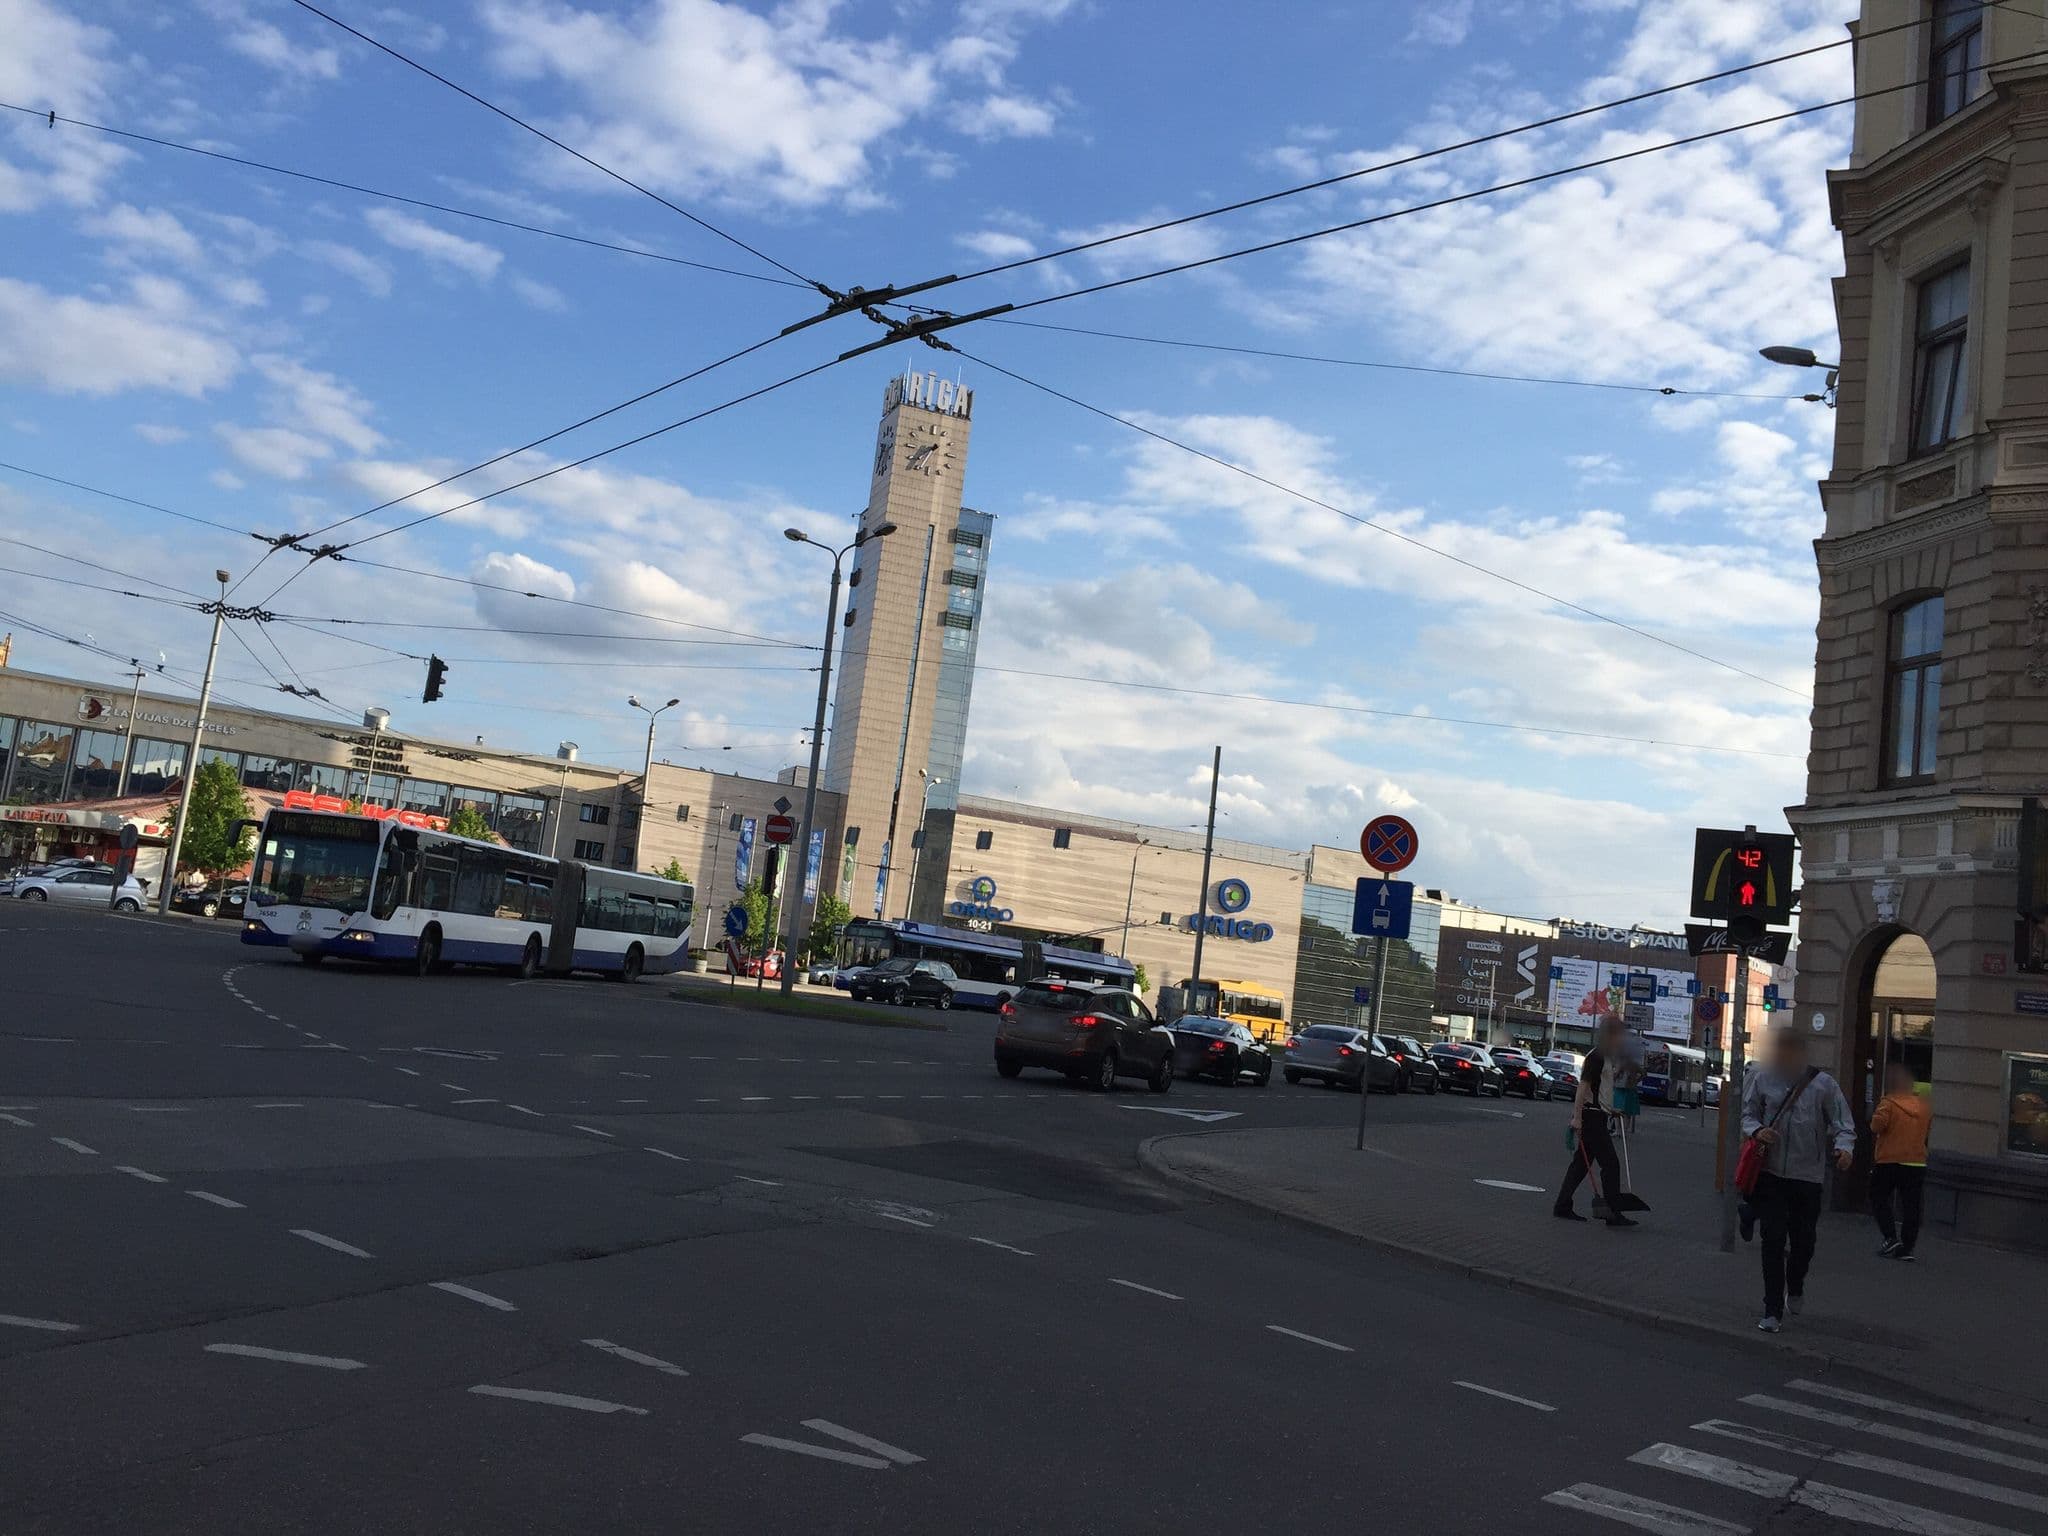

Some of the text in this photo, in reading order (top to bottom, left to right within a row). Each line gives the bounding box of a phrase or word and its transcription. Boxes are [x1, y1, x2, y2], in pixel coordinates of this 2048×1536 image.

[908, 370, 969, 416] RĪGA
[113, 709, 169, 725] LAVIJAS
[172, 718, 237, 736] DZEZCEĻS
[1737, 850, 1761, 868] 42
[950, 900, 1014, 922] ORIGO
[1189, 912, 1274, 941] ORIGO
